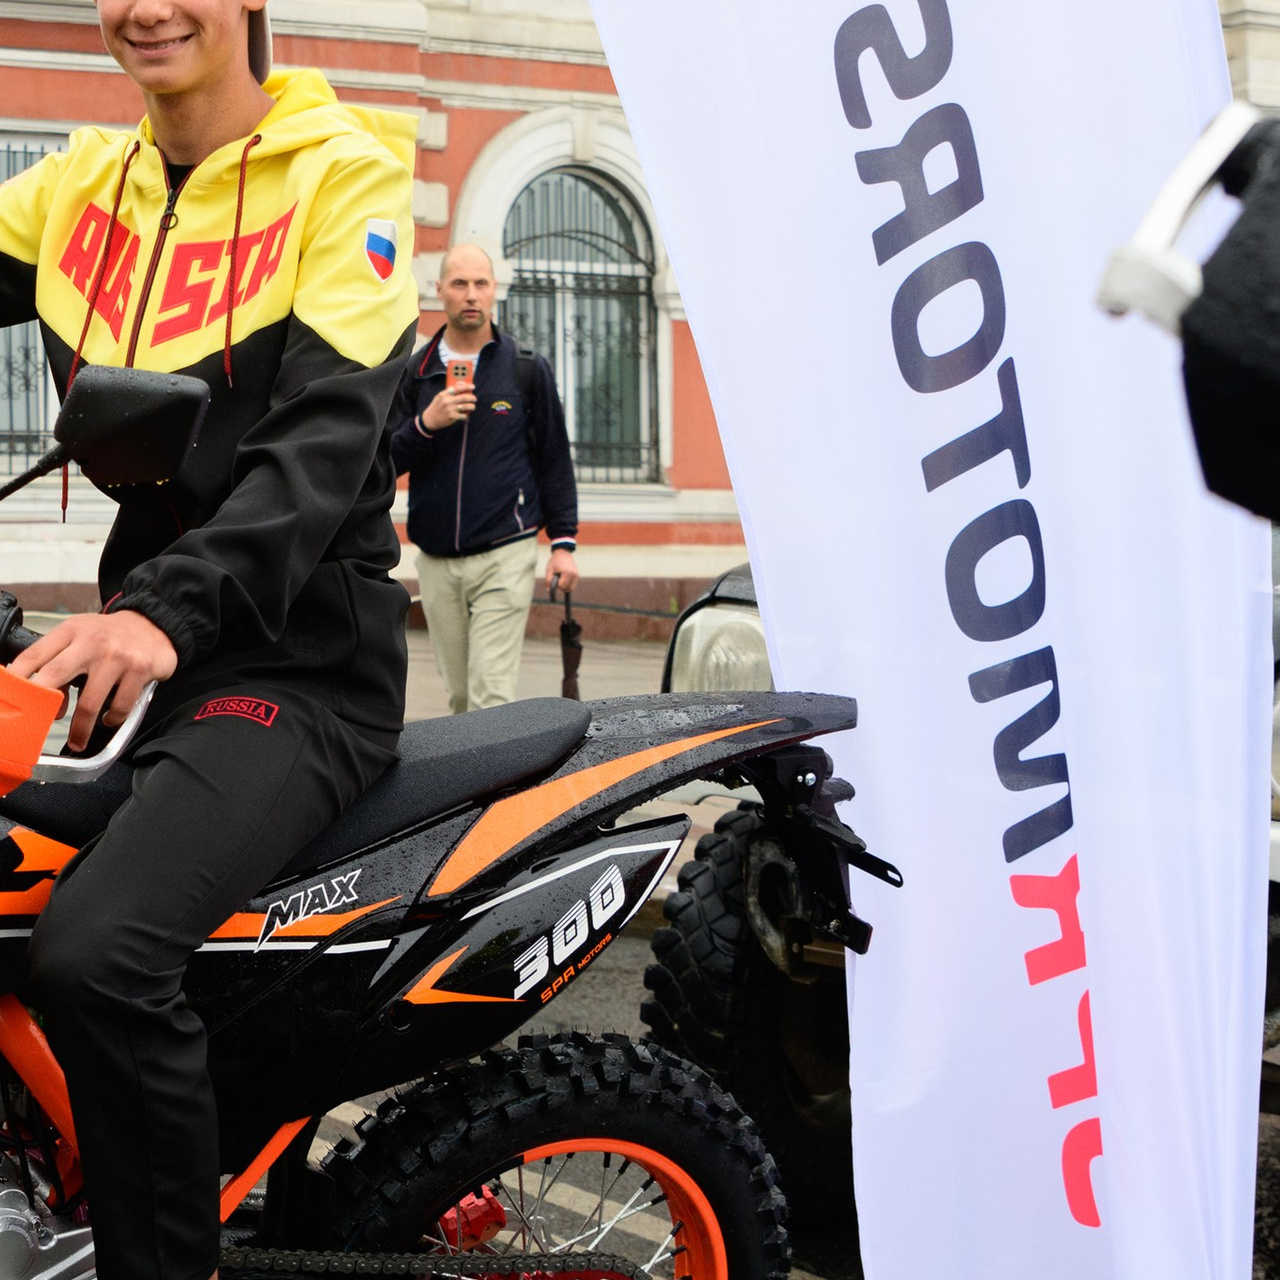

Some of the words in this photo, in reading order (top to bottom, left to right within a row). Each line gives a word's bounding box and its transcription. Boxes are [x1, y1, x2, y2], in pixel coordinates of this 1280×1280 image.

[206, 699, 267, 720] RUSSIA
[254, 868, 362, 953] MAX
[513, 863, 626, 1001] 300
[540, 965, 577, 1004] SPR
[577, 932, 613, 970] MOTORS
